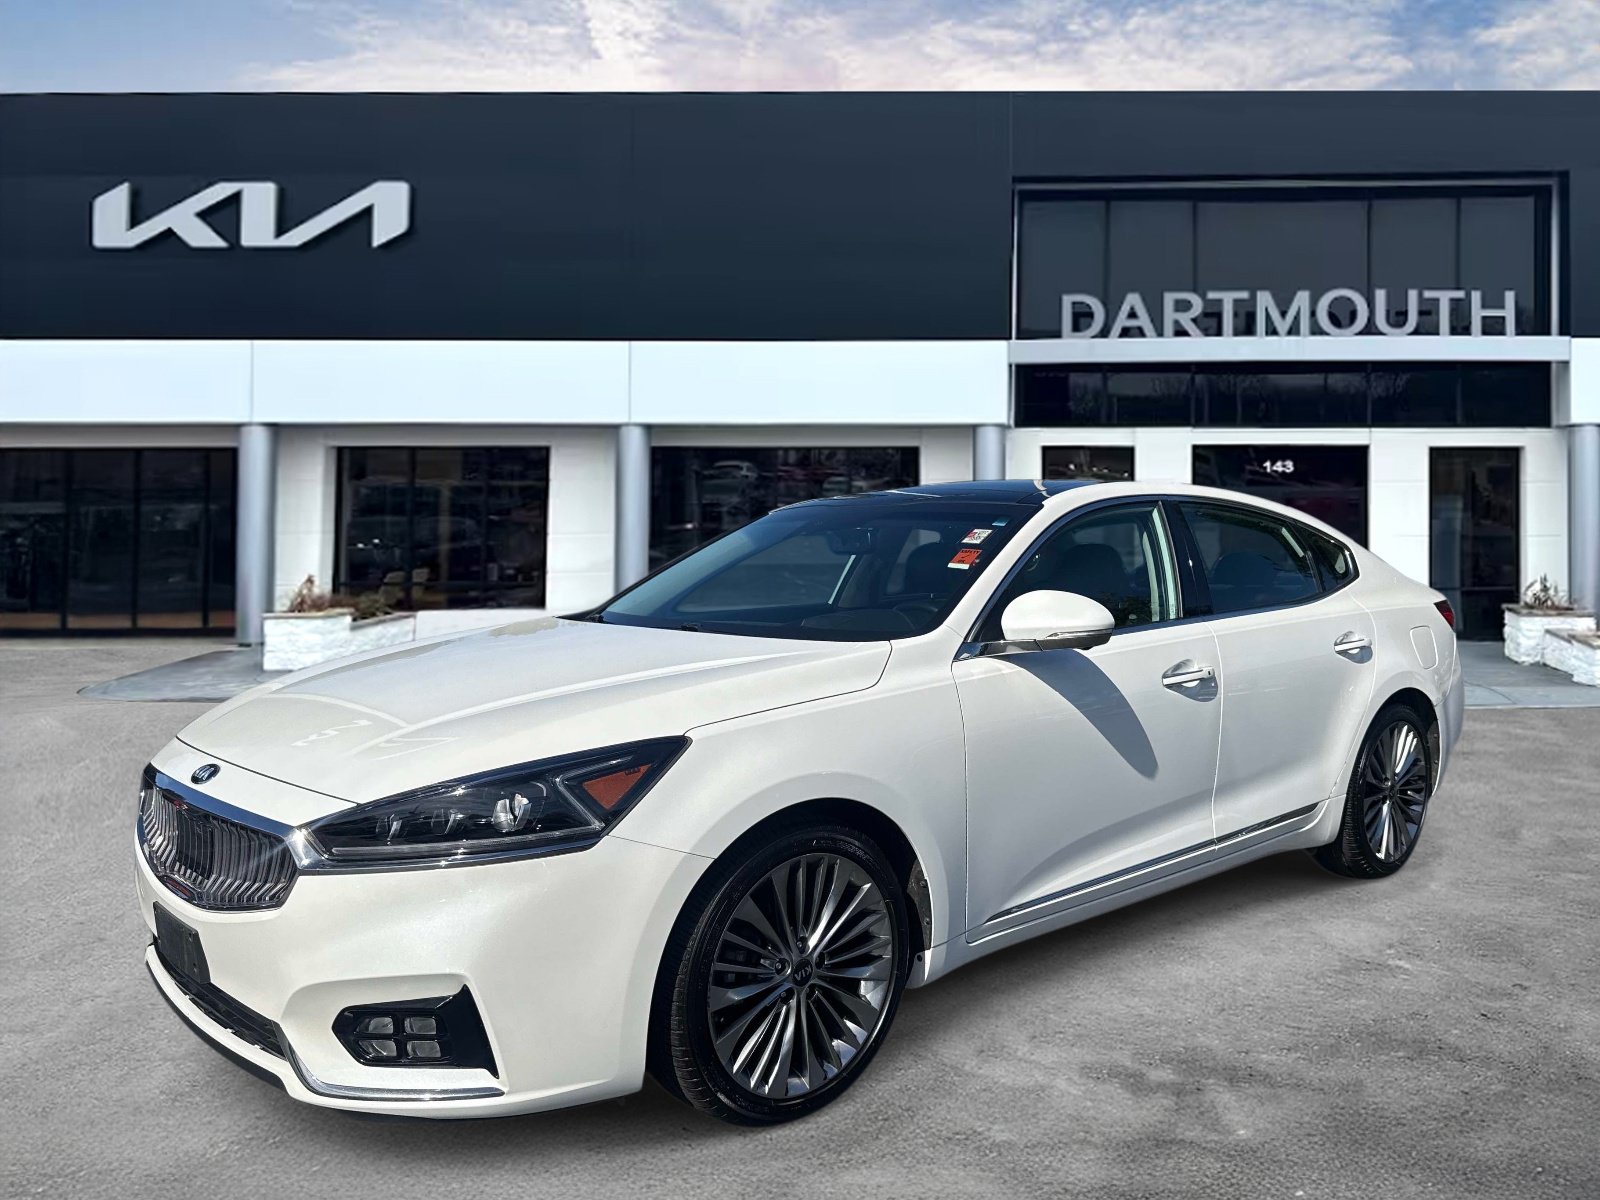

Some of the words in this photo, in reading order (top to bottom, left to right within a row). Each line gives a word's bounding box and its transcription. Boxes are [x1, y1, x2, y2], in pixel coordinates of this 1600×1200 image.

[92, 180, 410, 249] KIA
[1060, 288, 1517, 338] DARTMOUTH
[1262, 459, 1295, 474] 143
[794, 965, 812, 981] KIA
